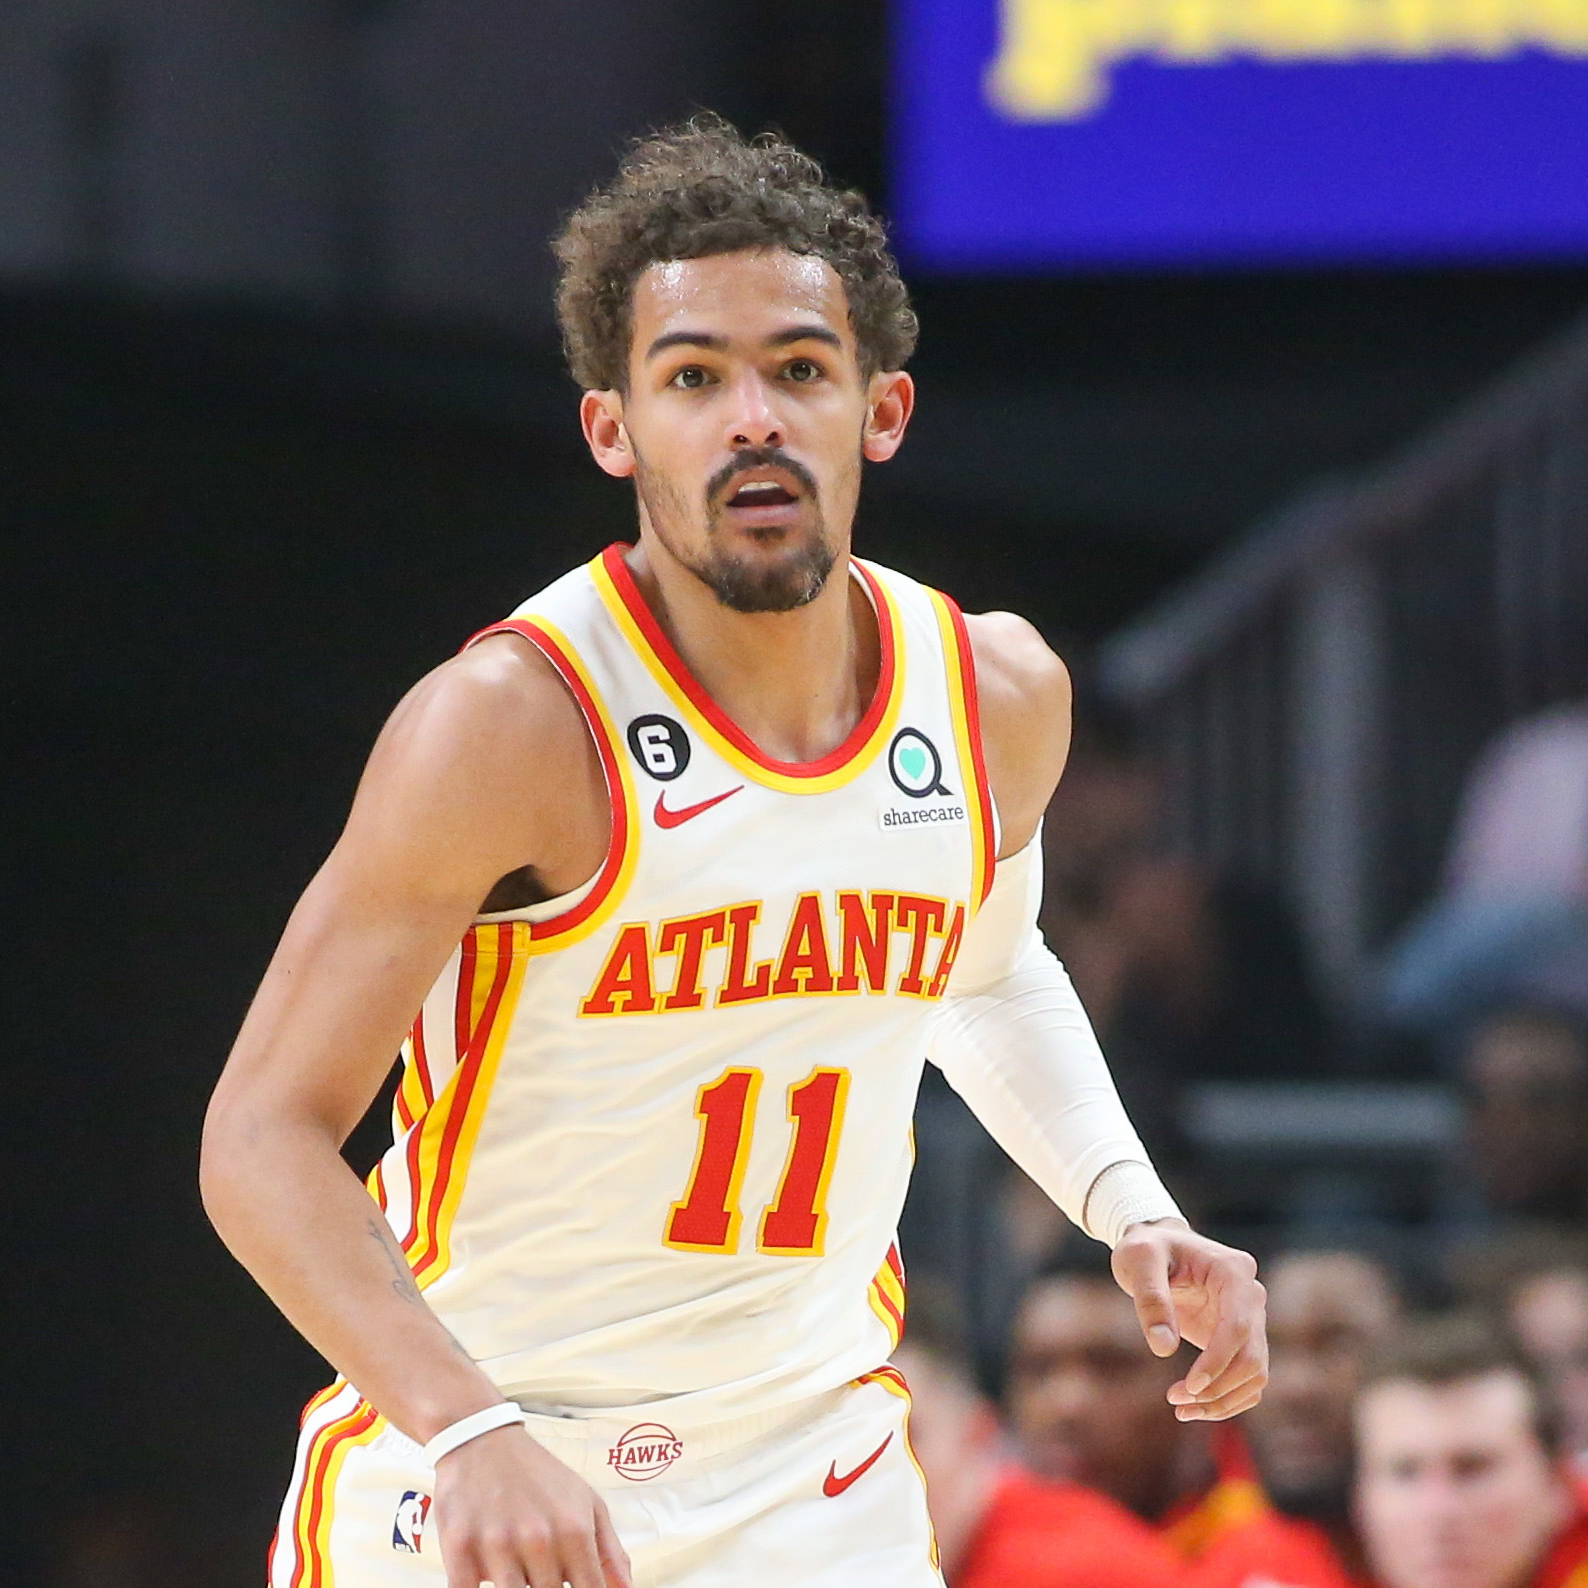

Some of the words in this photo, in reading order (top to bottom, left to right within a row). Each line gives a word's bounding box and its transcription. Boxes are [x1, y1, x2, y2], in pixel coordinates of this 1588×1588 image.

[636, 724, 678, 773] 6
[883, 806, 965, 827] sharecare
[662, 1065, 852, 1256] 11
[606, 1440, 684, 1466] HAWKS
